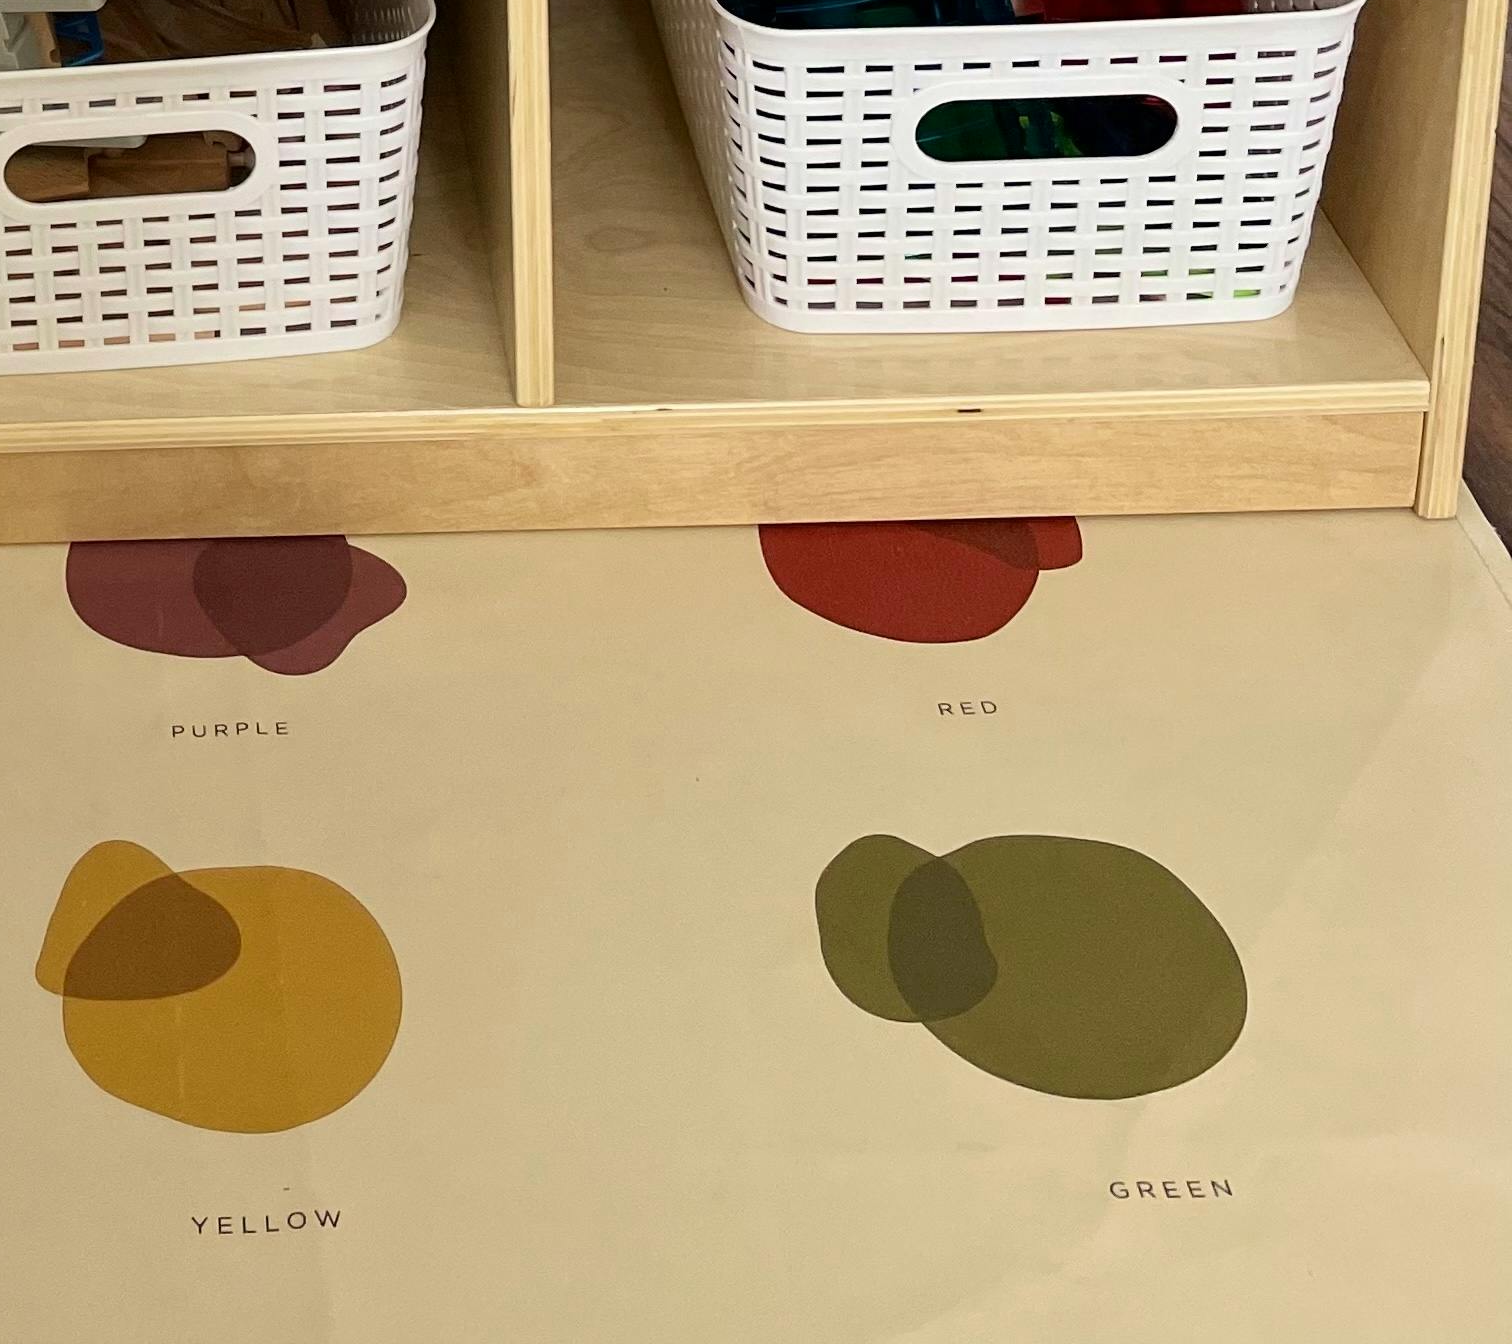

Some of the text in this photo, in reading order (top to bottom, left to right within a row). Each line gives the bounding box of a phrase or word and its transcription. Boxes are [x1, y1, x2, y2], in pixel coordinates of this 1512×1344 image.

[937, 700, 998, 716] RED
[171, 721, 289, 739] PURPLE
[1109, 1178, 1233, 1200] GREEN
[190, 1209, 341, 1235] YELLOW
